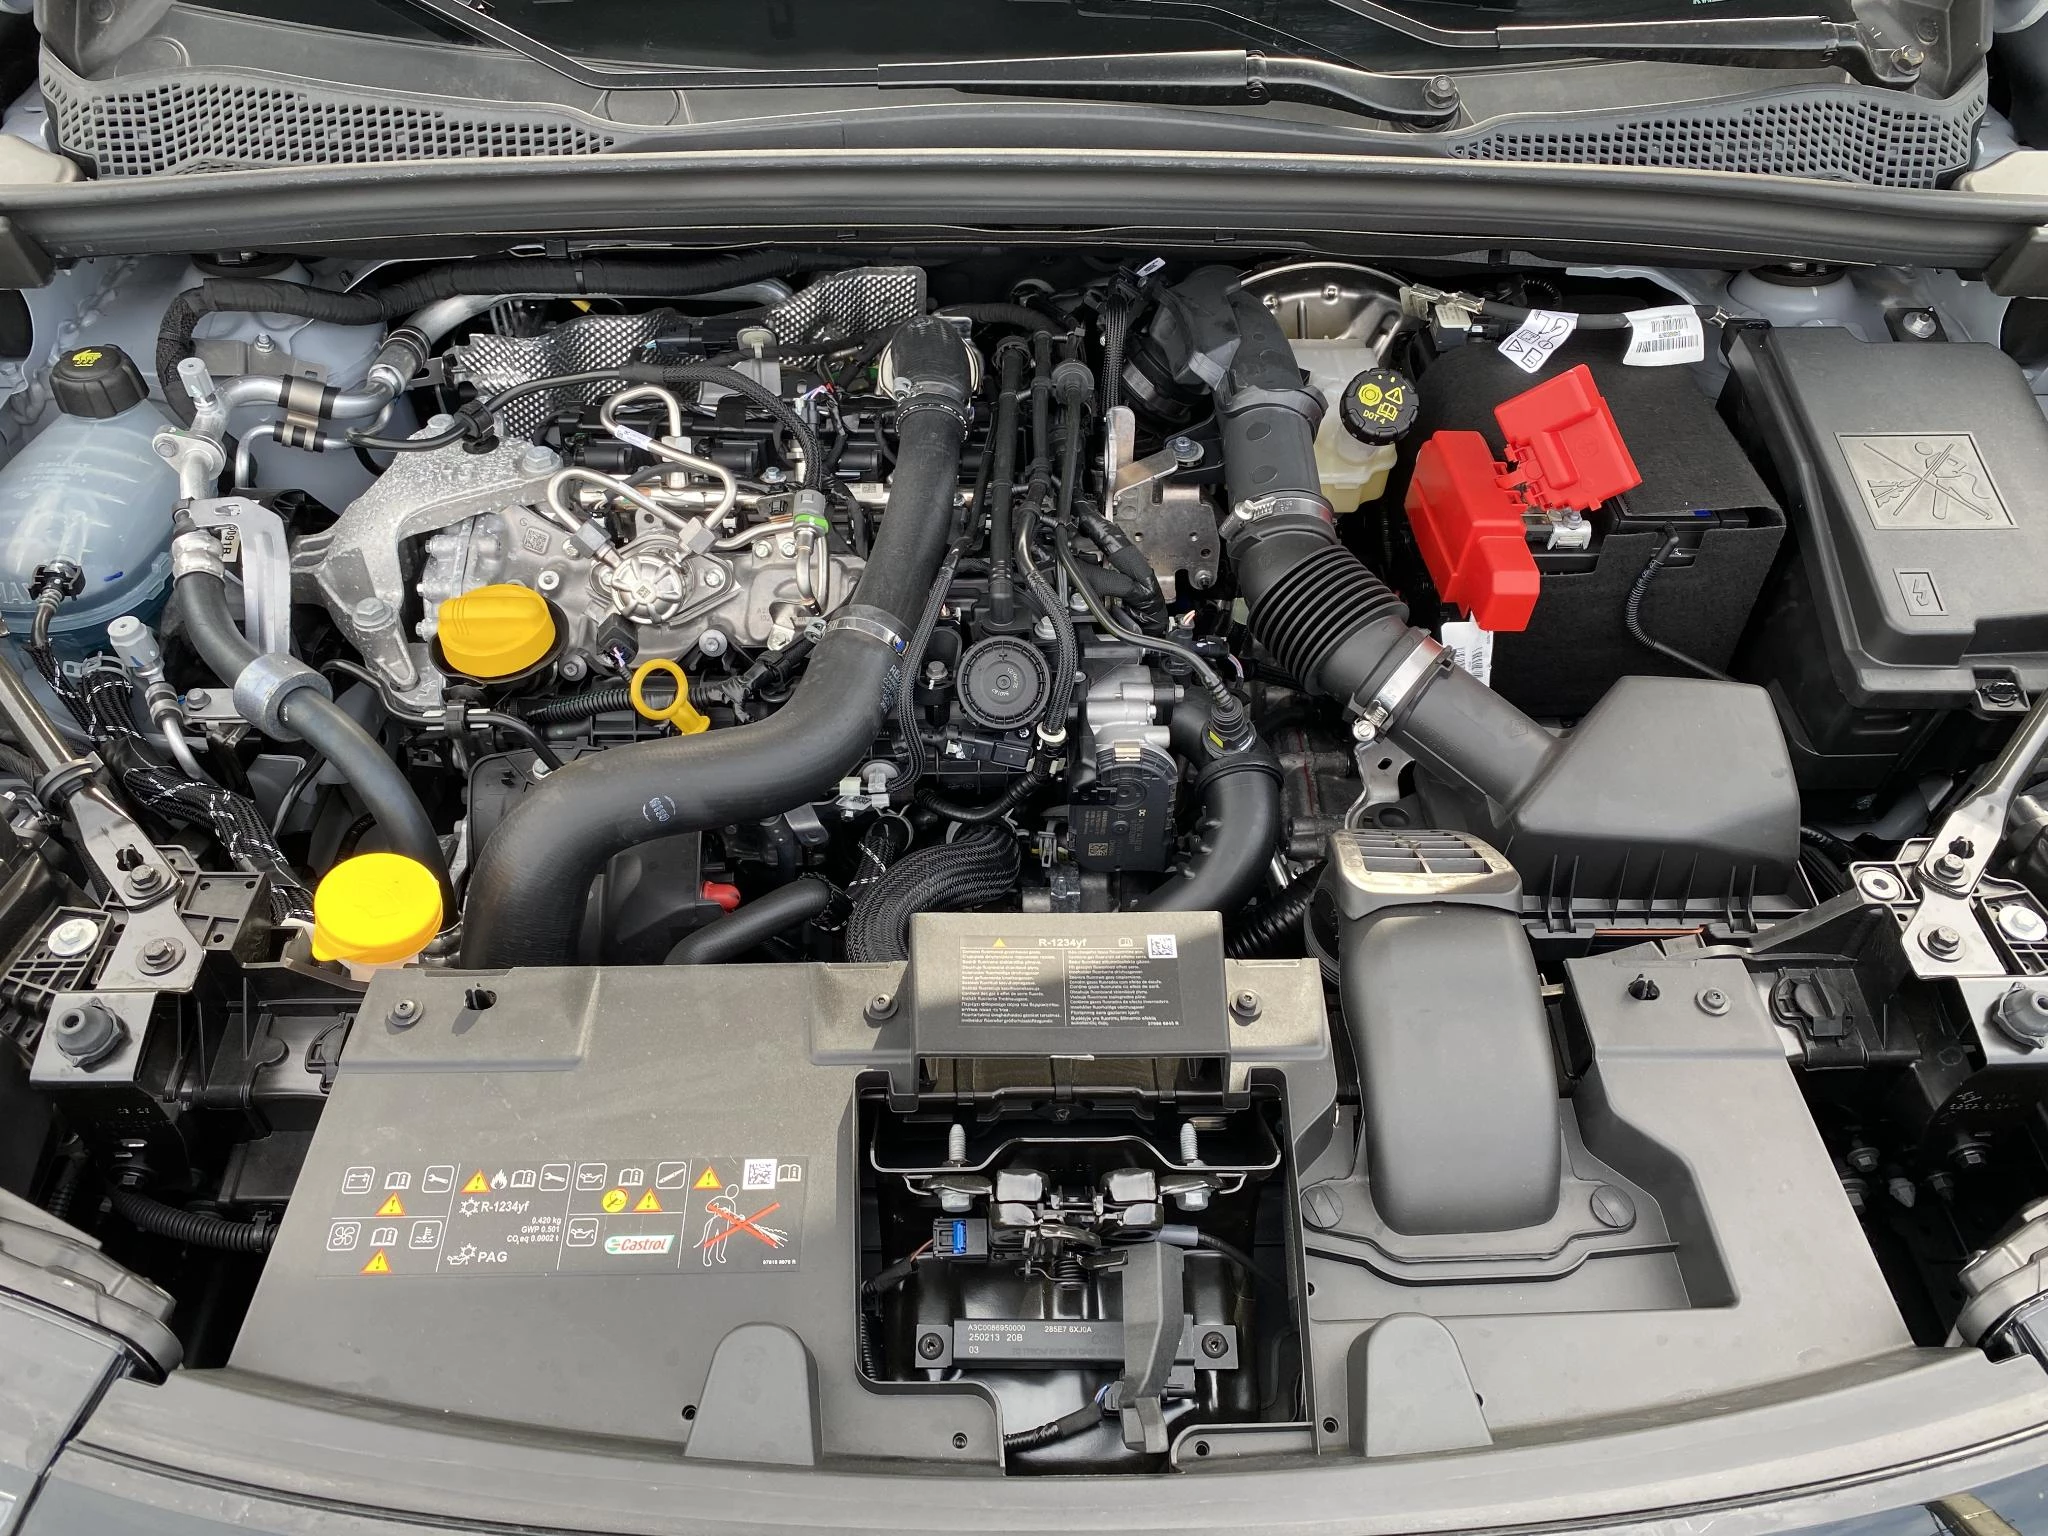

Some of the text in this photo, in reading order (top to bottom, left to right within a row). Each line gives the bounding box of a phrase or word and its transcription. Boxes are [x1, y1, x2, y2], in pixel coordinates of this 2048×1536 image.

[1362, 409, 1386, 425] DOT 4
[1038, 938, 1087, 948] R-1234yf
[480, 1200, 530, 1215] R-1234yf
[531, 1216, 562, 1226] 0.420 kg
[521, 1226, 560, 1234] GWP 0.501
[621, 1238, 667, 1251] Castrol
[477, 1250, 508, 1263] PAG
[968, 1333, 1023, 1342] 250213 20B
[968, 1345, 979, 1354] 03
